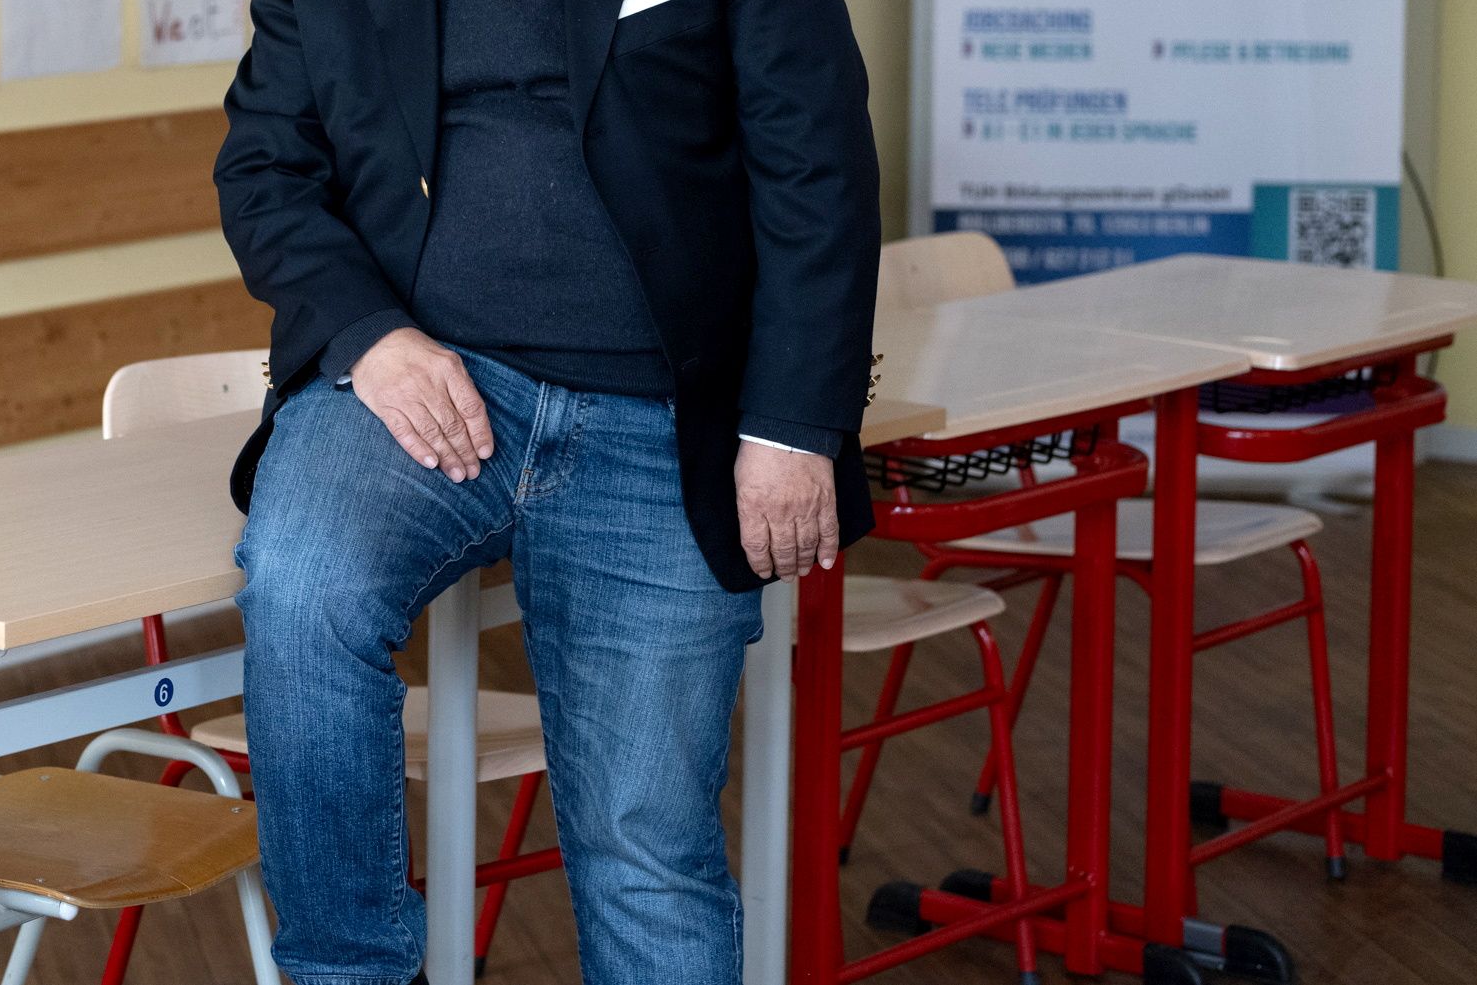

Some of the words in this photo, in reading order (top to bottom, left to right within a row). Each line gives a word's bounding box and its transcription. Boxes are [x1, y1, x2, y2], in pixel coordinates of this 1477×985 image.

[1253, 41, 1352, 63] BETREUUNG
[1014, 87, 1128, 113] PRÜFUNGEN
[1004, 184, 1154, 203] Bildungszentrum
[159, 683, 169, 703] 6
